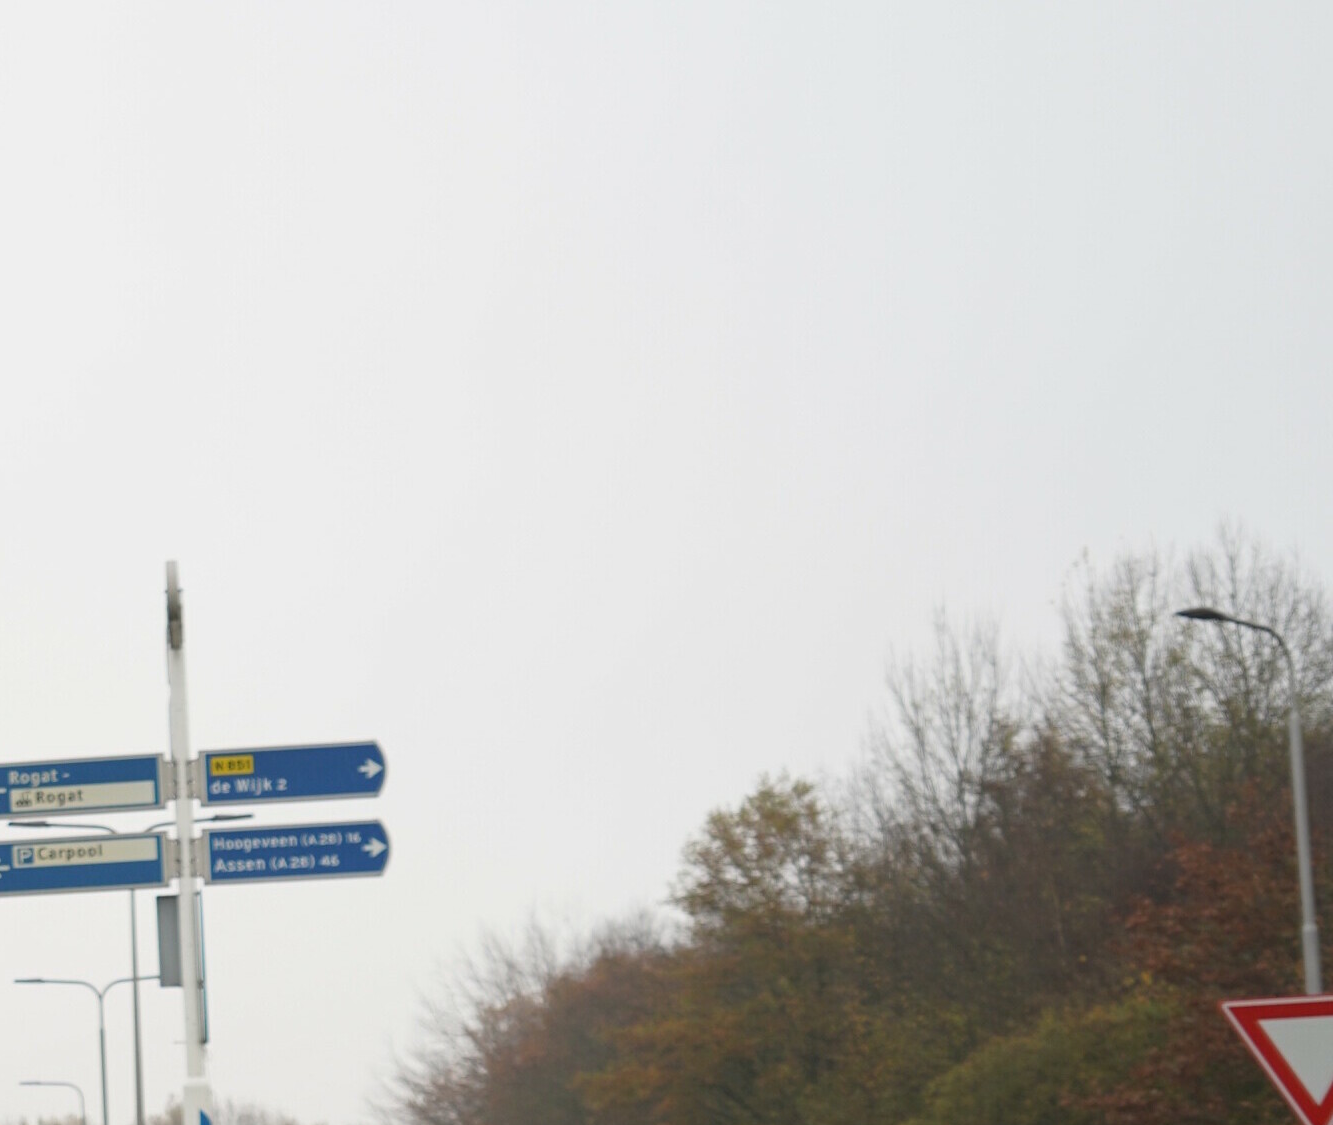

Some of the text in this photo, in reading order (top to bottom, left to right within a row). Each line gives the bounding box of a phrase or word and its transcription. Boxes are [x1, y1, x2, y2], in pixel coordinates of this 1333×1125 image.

[8, 769, 59, 787] Rogat
[209, 777, 288, 796] de Wijk 2
[35, 789, 83, 806] Rogat
[213, 835, 298, 853] Hoogeveen
[346, 832, 362, 844] 16
[37, 843, 103, 861] Carpool
[214, 857, 266, 873] Assen
